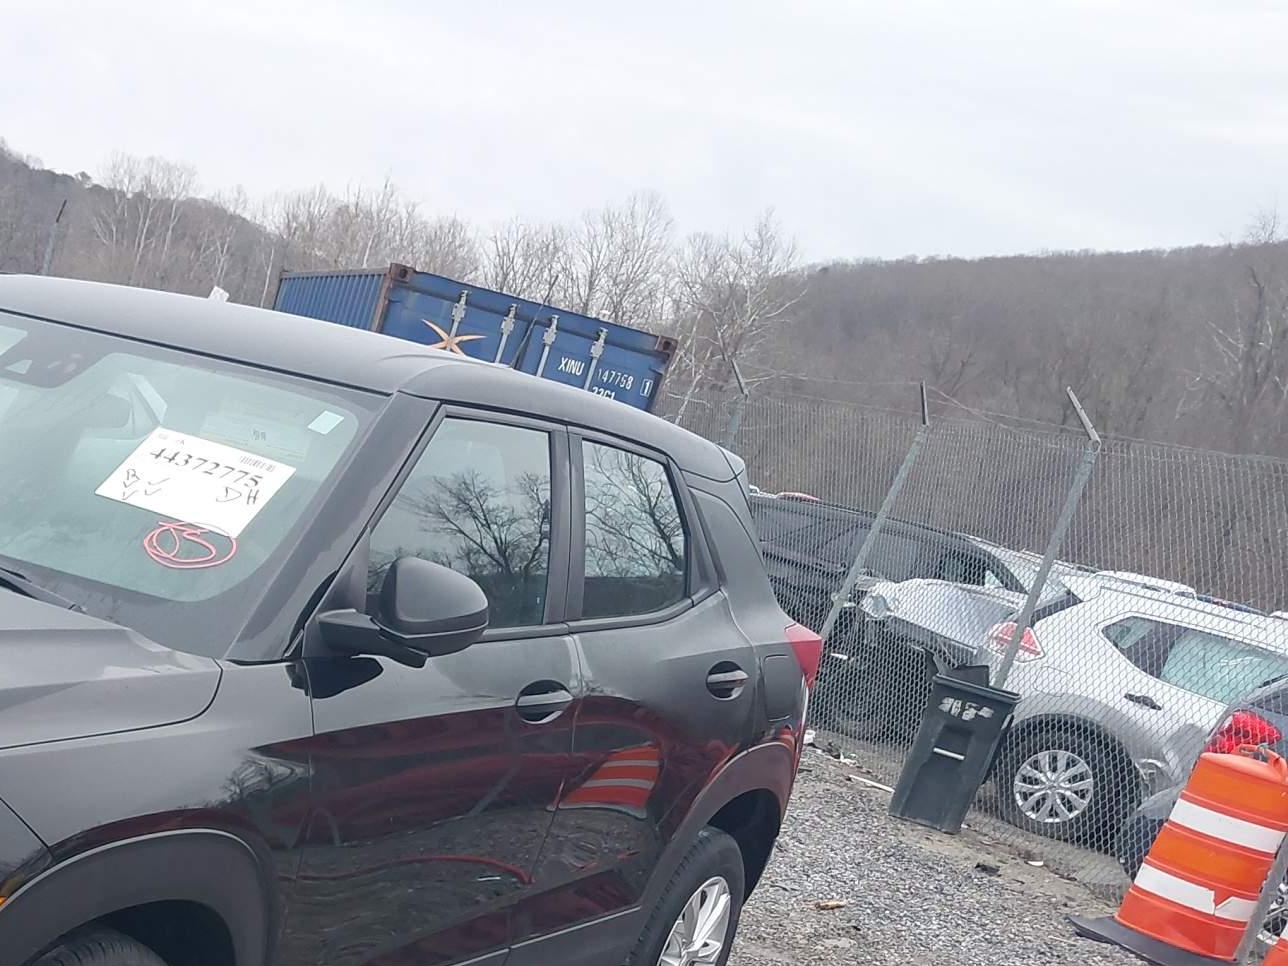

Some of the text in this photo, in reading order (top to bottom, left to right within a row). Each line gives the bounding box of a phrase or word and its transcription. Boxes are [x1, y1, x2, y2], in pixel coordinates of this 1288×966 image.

[558, 357, 585, 376] XINU
[641, 381, 652, 396] 1
[150, 448, 263, 488] 44372775
